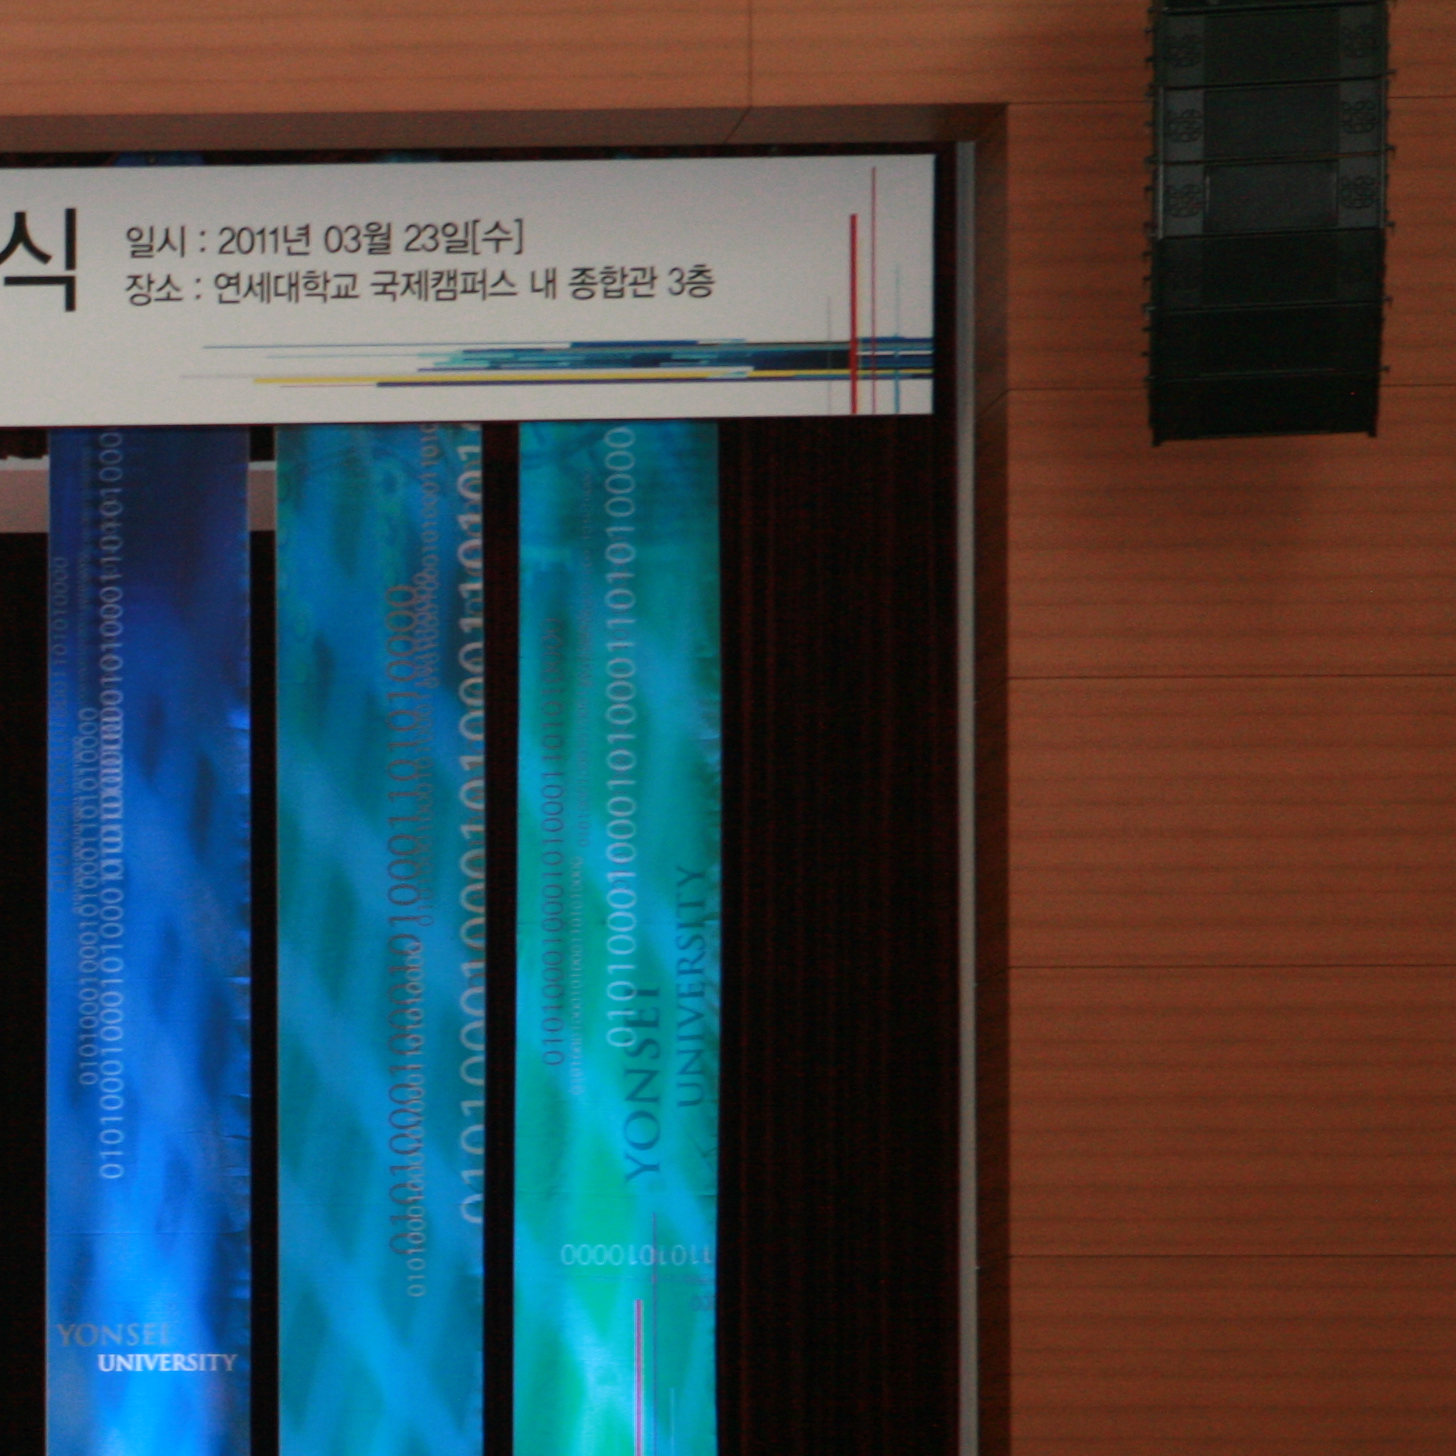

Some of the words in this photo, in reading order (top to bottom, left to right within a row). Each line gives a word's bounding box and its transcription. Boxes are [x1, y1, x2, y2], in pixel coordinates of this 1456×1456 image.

[125, 225, 186, 259] 일시
[217, 223, 311, 257] 2011년
[323, 221, 392, 256] 03월
[403, 217, 524, 256] 23일[수]
[124, 272, 184, 307] 장소
[213, 269, 361, 305] 연세대학교
[369, 268, 519, 303] 국제캠퍼스
[530, 267, 557, 300] 내
[568, 265, 659, 301] 종합관
[667, 263, 716, 299] 3층
[674, 864, 708, 1108] UNIVERSITY
[622, 985, 662, 1183] YONSEI
[56, 1322, 171, 1347] YONSEI
[97, 1353, 238, 1372] UNIVERSITY
